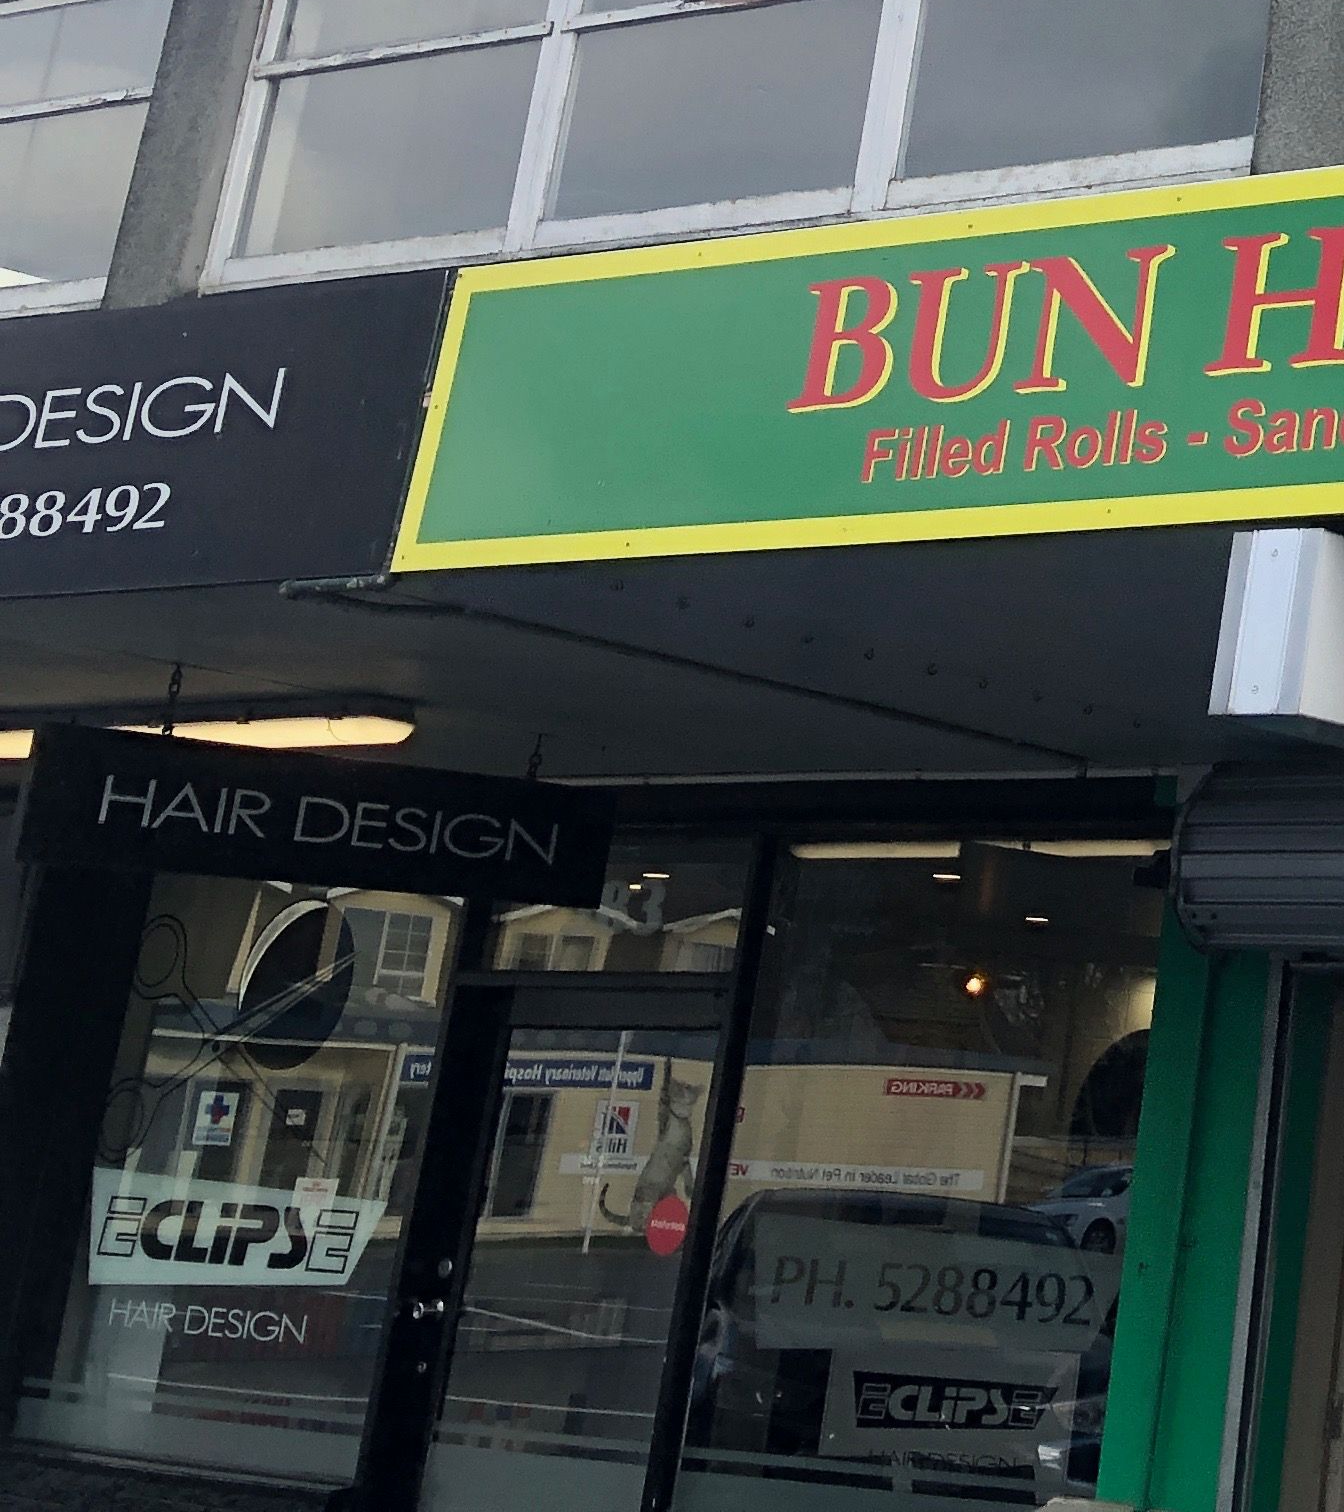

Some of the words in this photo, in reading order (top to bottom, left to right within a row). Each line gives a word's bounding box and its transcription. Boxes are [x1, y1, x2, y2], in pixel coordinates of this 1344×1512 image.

[787, 245, 1176, 413] BUN
[861, 419, 1011, 484] Filled
[1024, 409, 1168, 472] Rolls
[0, 482, 172, 539] 88492
[98, 774, 271, 838] HAIR
[294, 795, 558, 866] DESIGN
[108, 1297, 177, 1333] HAIR
[183, 1304, 308, 1345] DESIGN
[771, 1255, 854, 1309] PH.
[874, 1262, 1095, 1326] 5288492
